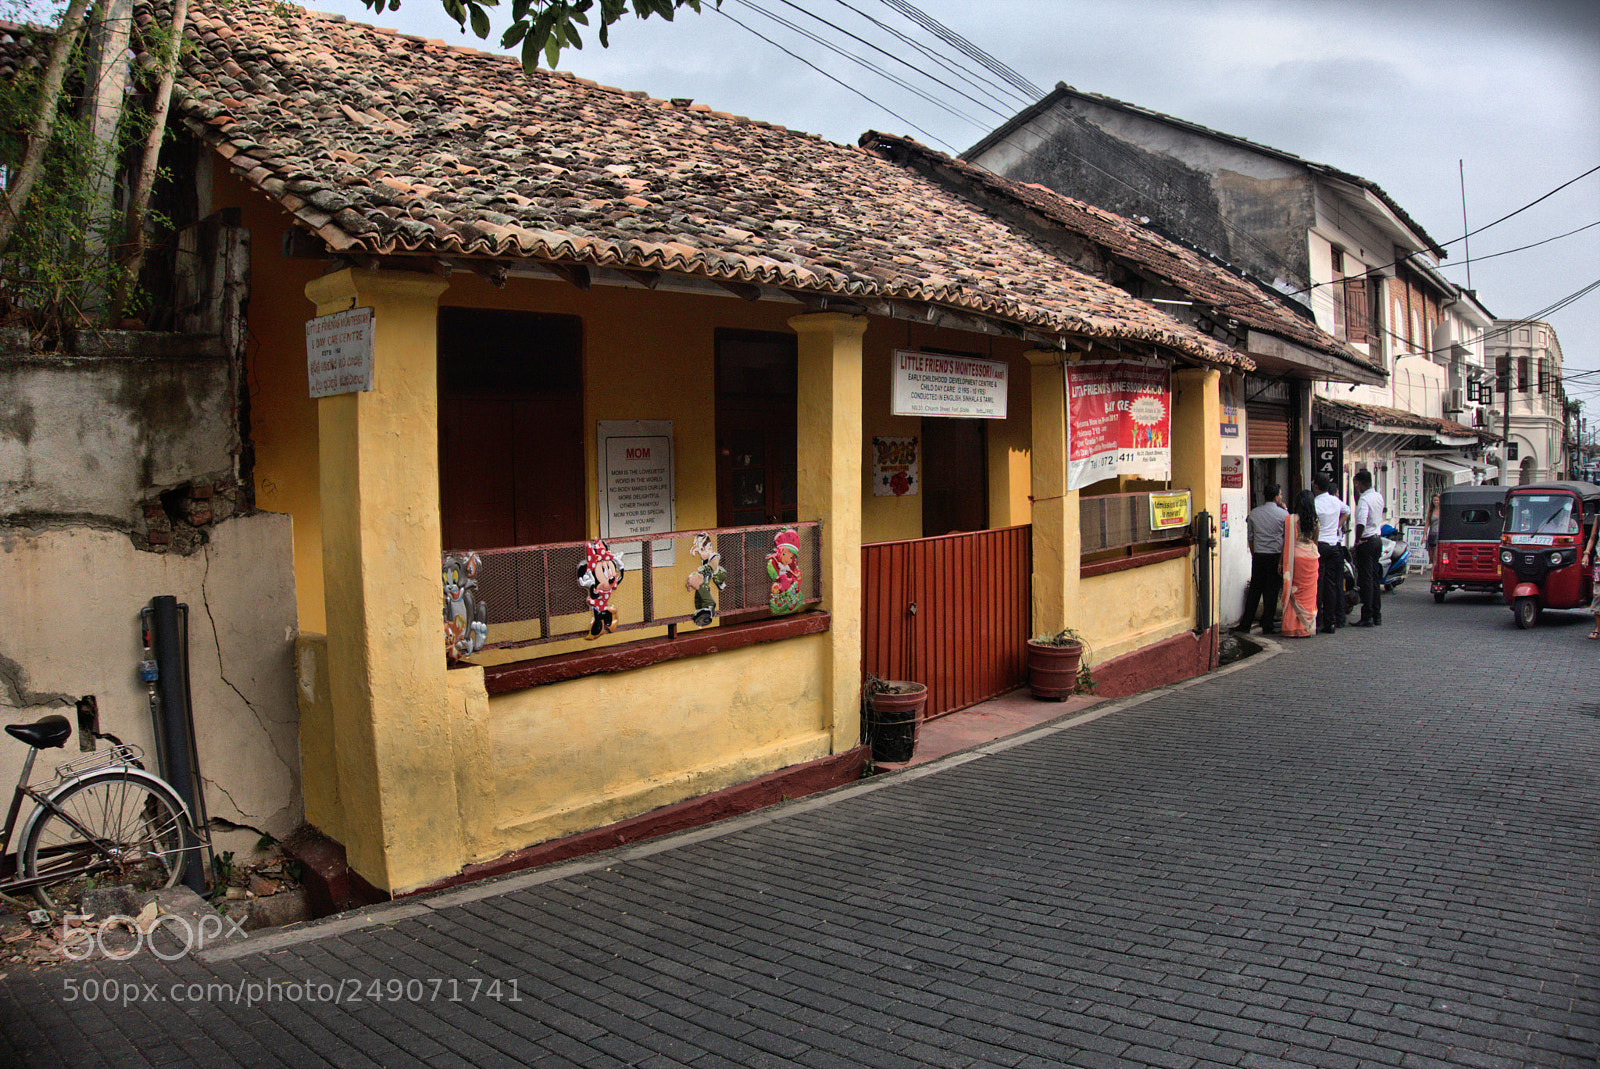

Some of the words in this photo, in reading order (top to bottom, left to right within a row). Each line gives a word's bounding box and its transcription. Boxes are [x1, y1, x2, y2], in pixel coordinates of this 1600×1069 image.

[339, 330, 363, 344] CENTRE
[900, 355, 923, 371] LITTLE
[924, 358, 954, 374] FRIEND'S
[908, 373, 922, 382] EARLY
[922, 374, 948, 384] CHILDHOOD
[948, 376, 978, 386] DEVELOPMENT
[978, 378, 994, 388] CENTRE
[920, 383, 934, 392] CHILD
[934, 384, 943, 392] DAY
[944, 386, 956, 394] CARE
[910, 392, 938, 401] CONDUCTED
[983, 396, 994, 404] TAMIL
[1317, 438, 1338, 448] DUTCH
[626, 448, 650, 459] MOM
[624, 468, 629, 476] IS
[636, 476, 646, 484] THE
[632, 492, 659, 500] DELIGHTFUL
